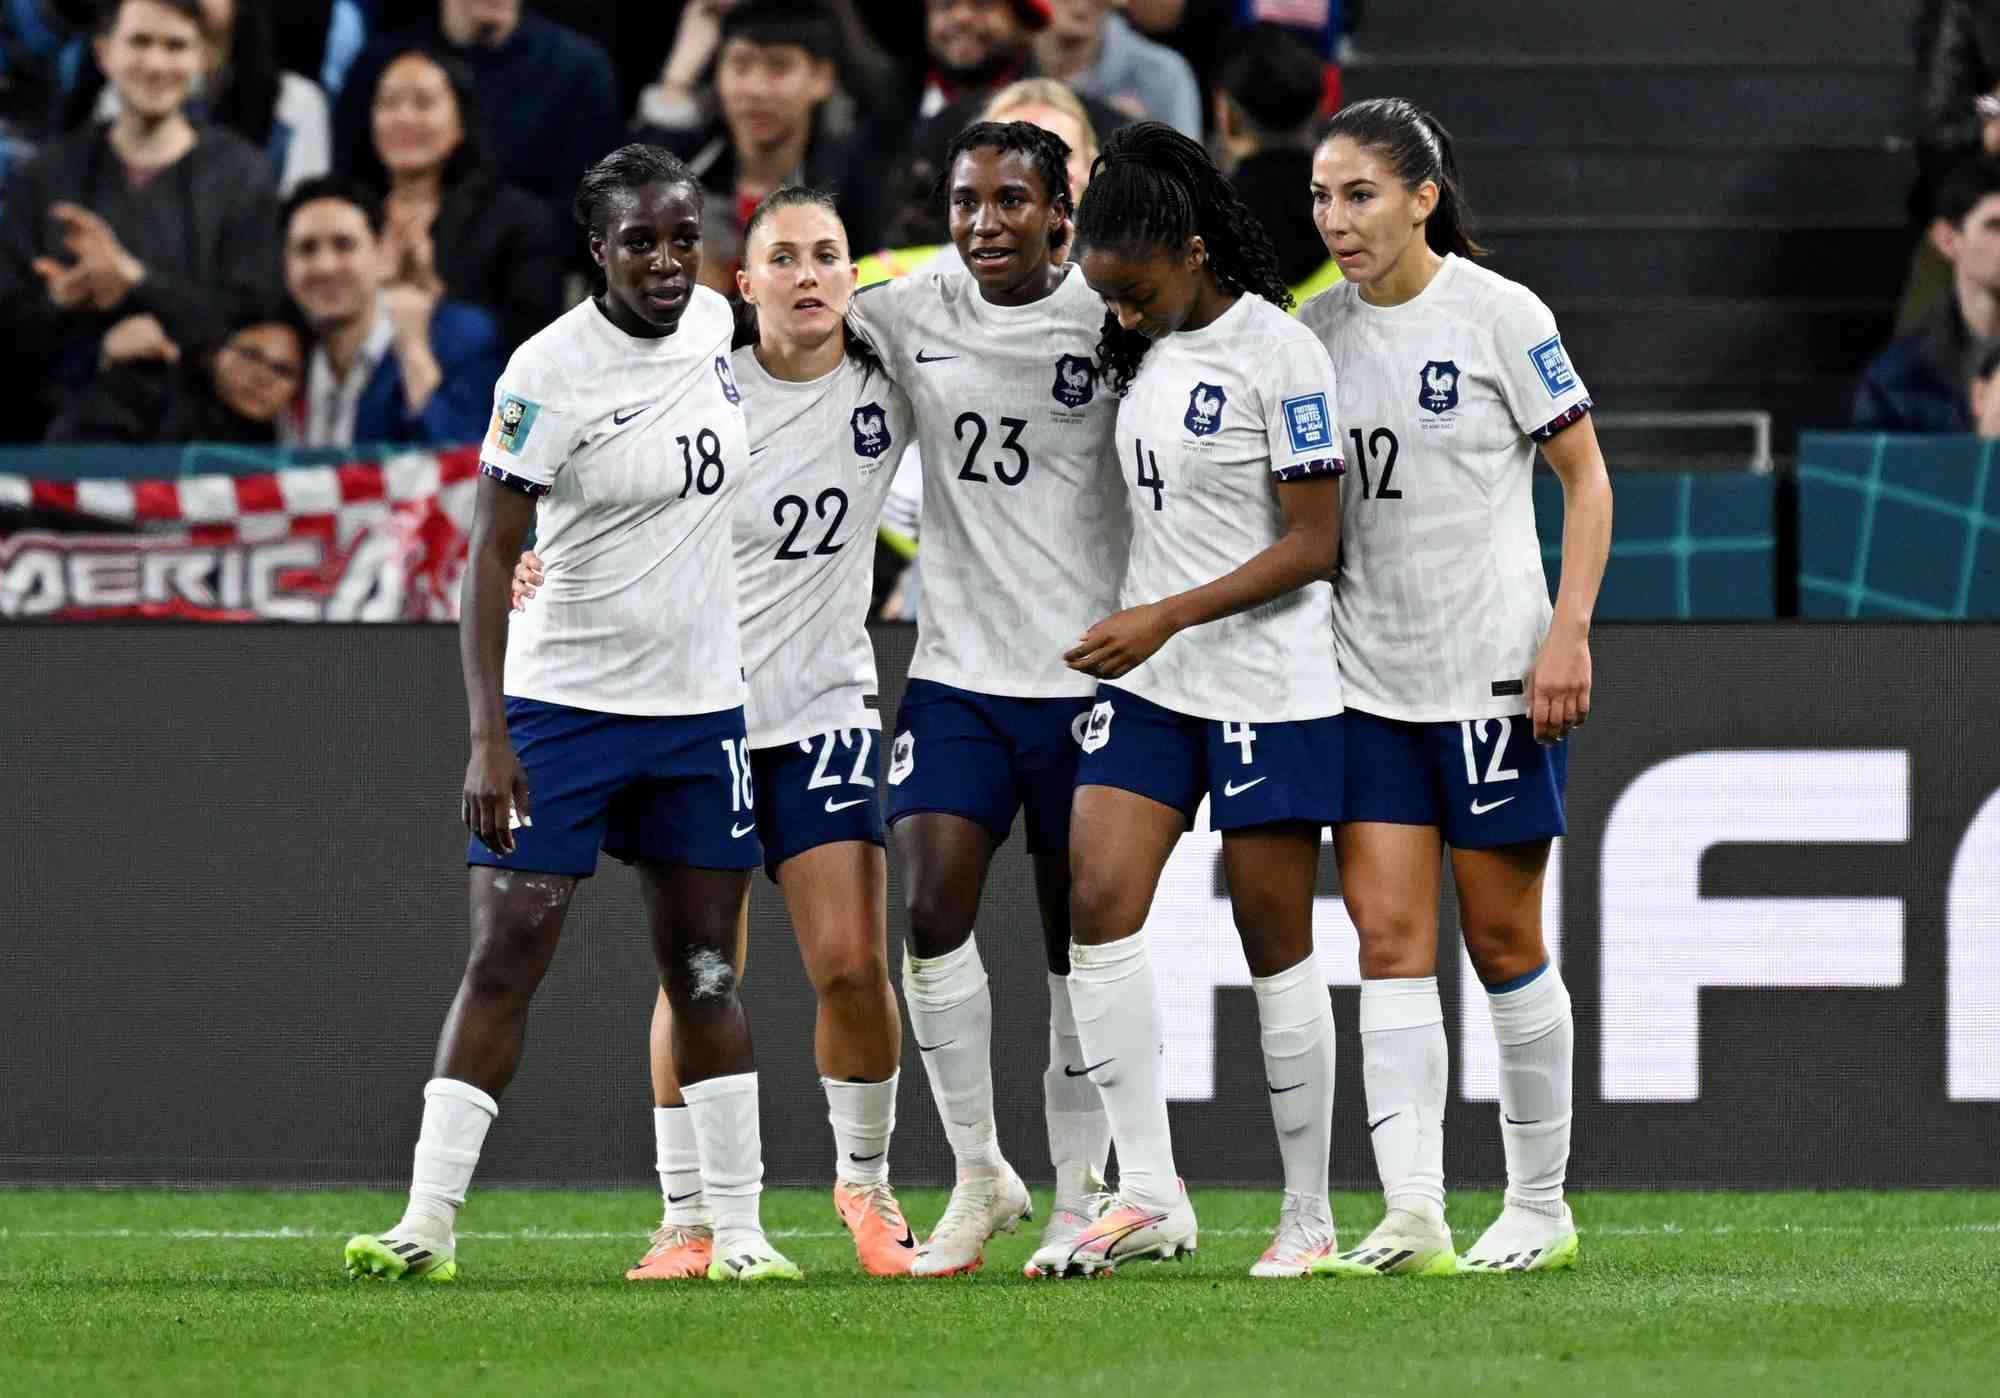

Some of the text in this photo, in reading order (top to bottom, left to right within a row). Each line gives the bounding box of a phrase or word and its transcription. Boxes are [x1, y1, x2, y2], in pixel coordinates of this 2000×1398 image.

[676, 427, 725, 499] 18
[954, 411, 1029, 486] 23
[1136, 438, 1164, 510] 4
[1349, 427, 1402, 500] 12
[773, 487, 849, 560] 22
[721, 737, 753, 812] 18
[800, 728, 875, 790] 22
[1461, 718, 1519, 785] 12
